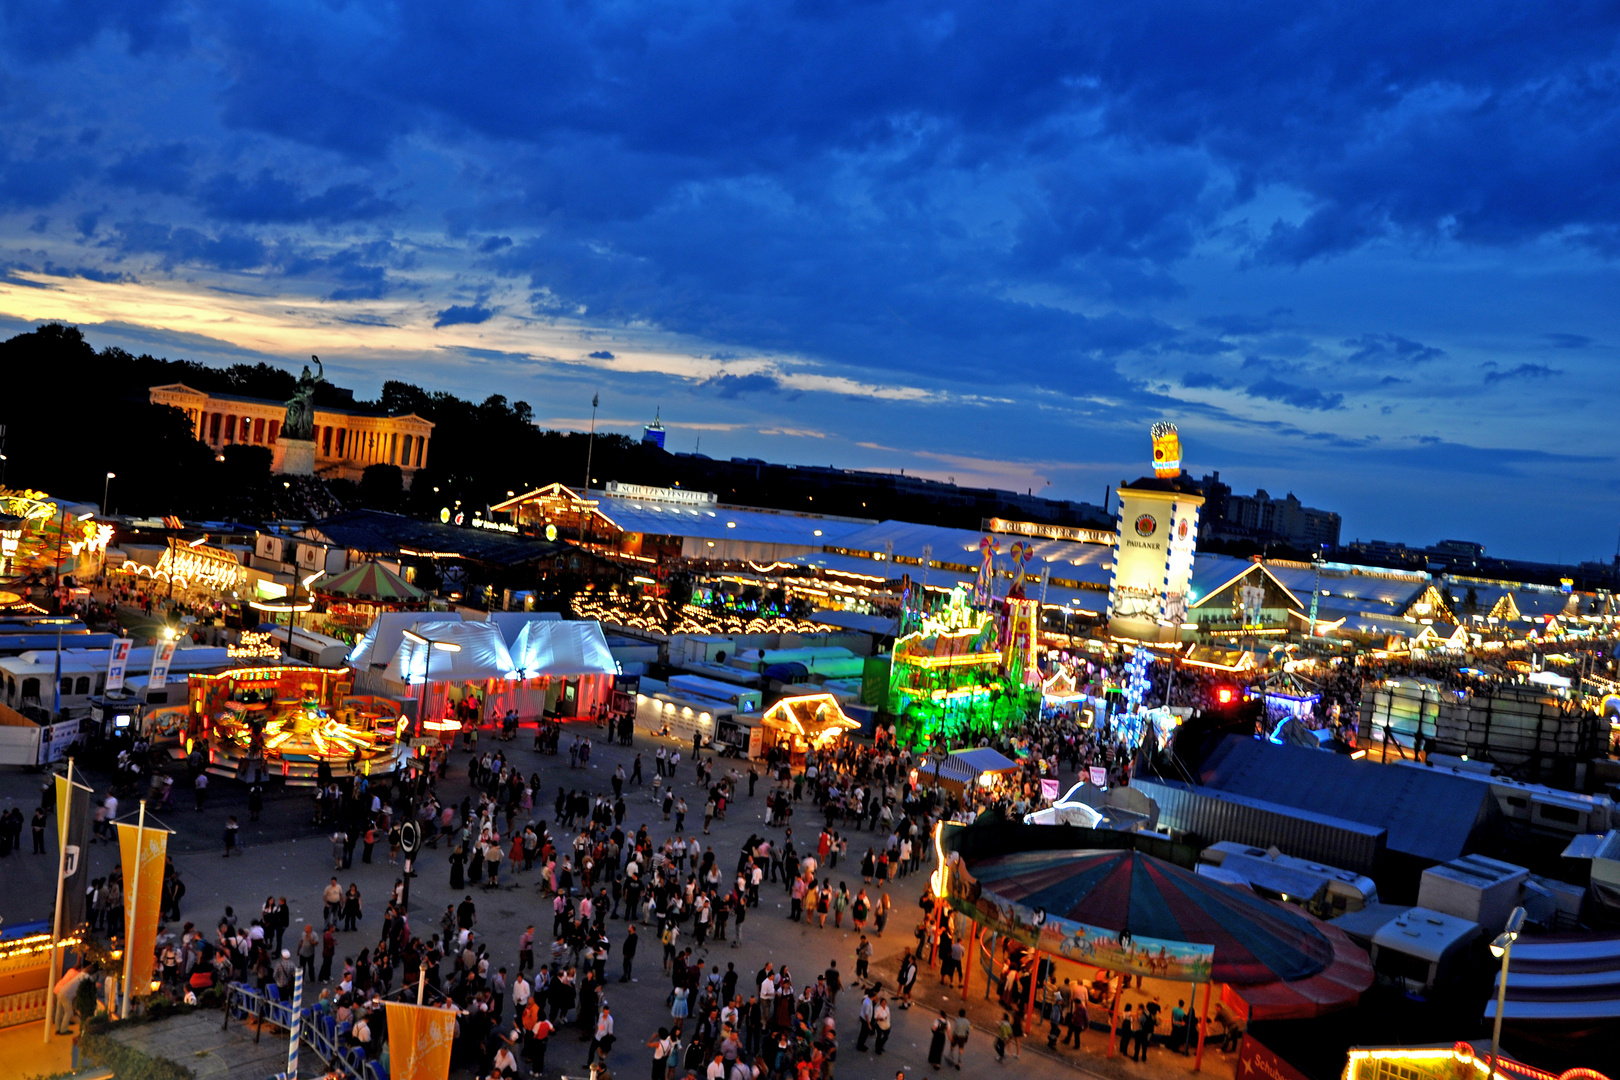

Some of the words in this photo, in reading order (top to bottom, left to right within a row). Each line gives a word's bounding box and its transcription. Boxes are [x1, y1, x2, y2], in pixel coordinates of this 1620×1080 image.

[1077, 530, 1116, 544] PAULAN
[1126, 539, 1161, 550] PAULANER
[1254, 1053, 1289, 1080] Schub
